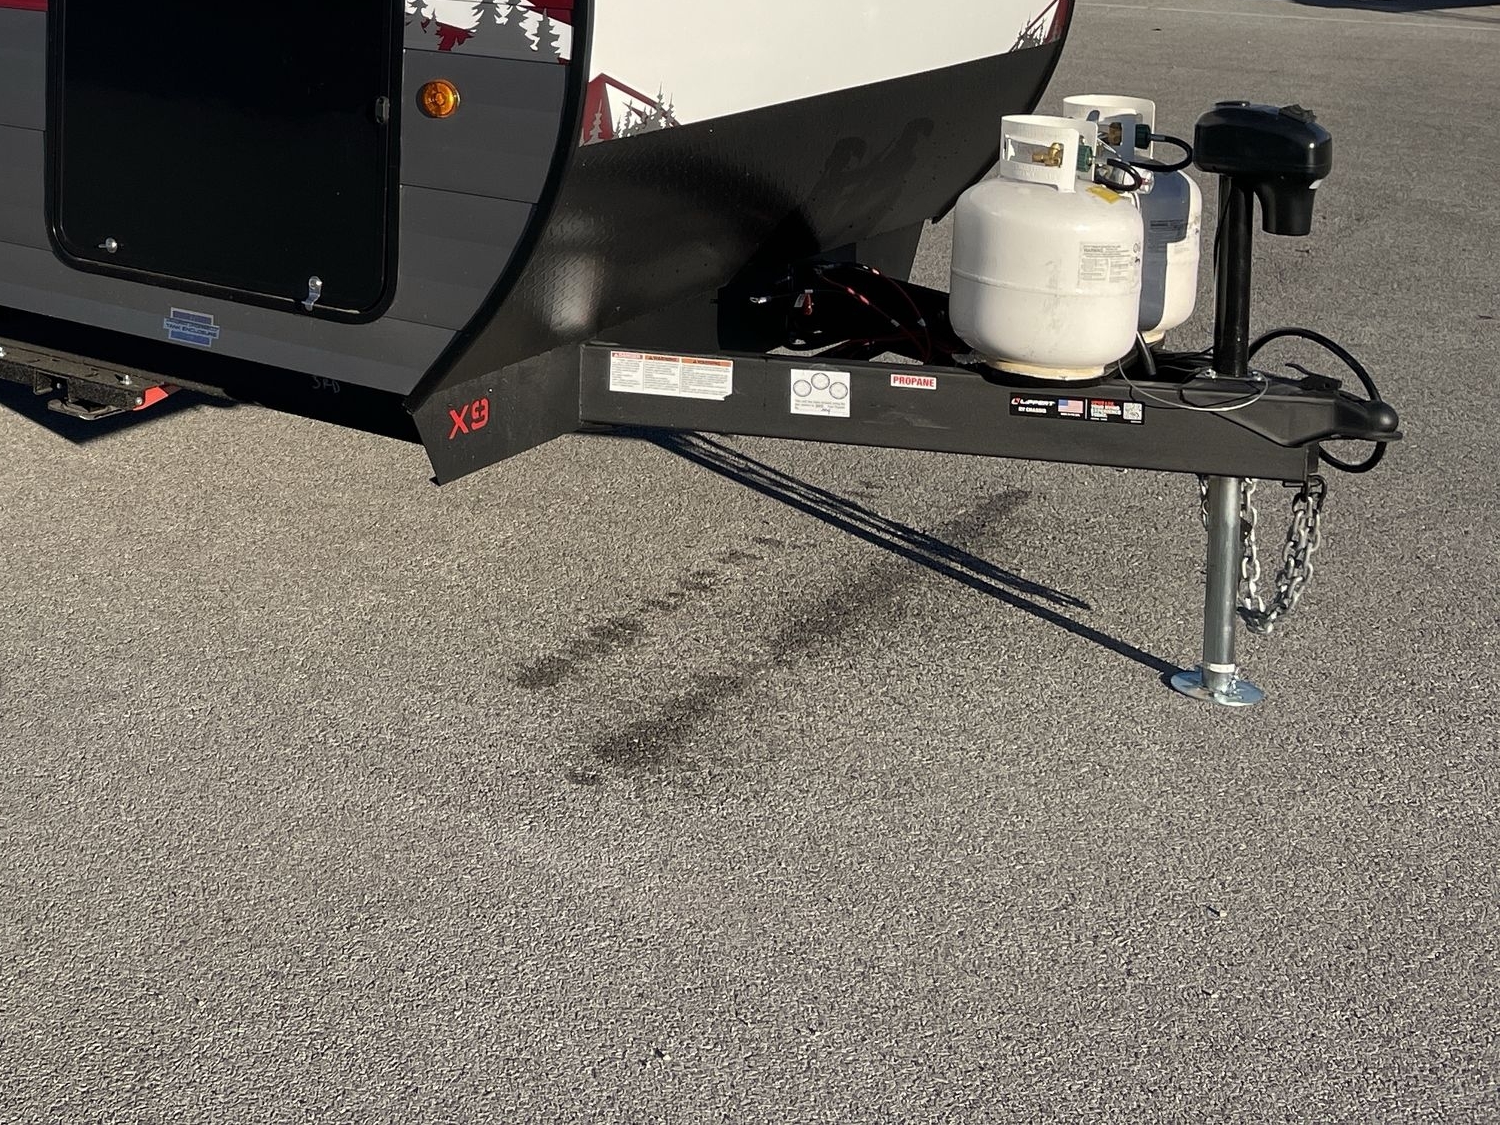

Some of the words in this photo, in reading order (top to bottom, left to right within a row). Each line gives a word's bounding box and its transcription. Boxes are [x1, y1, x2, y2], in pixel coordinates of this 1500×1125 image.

[893, 375, 935, 387] PROPANE
[1020, 398, 1056, 407] LIPPERT
[448, 397, 490, 440] X9
